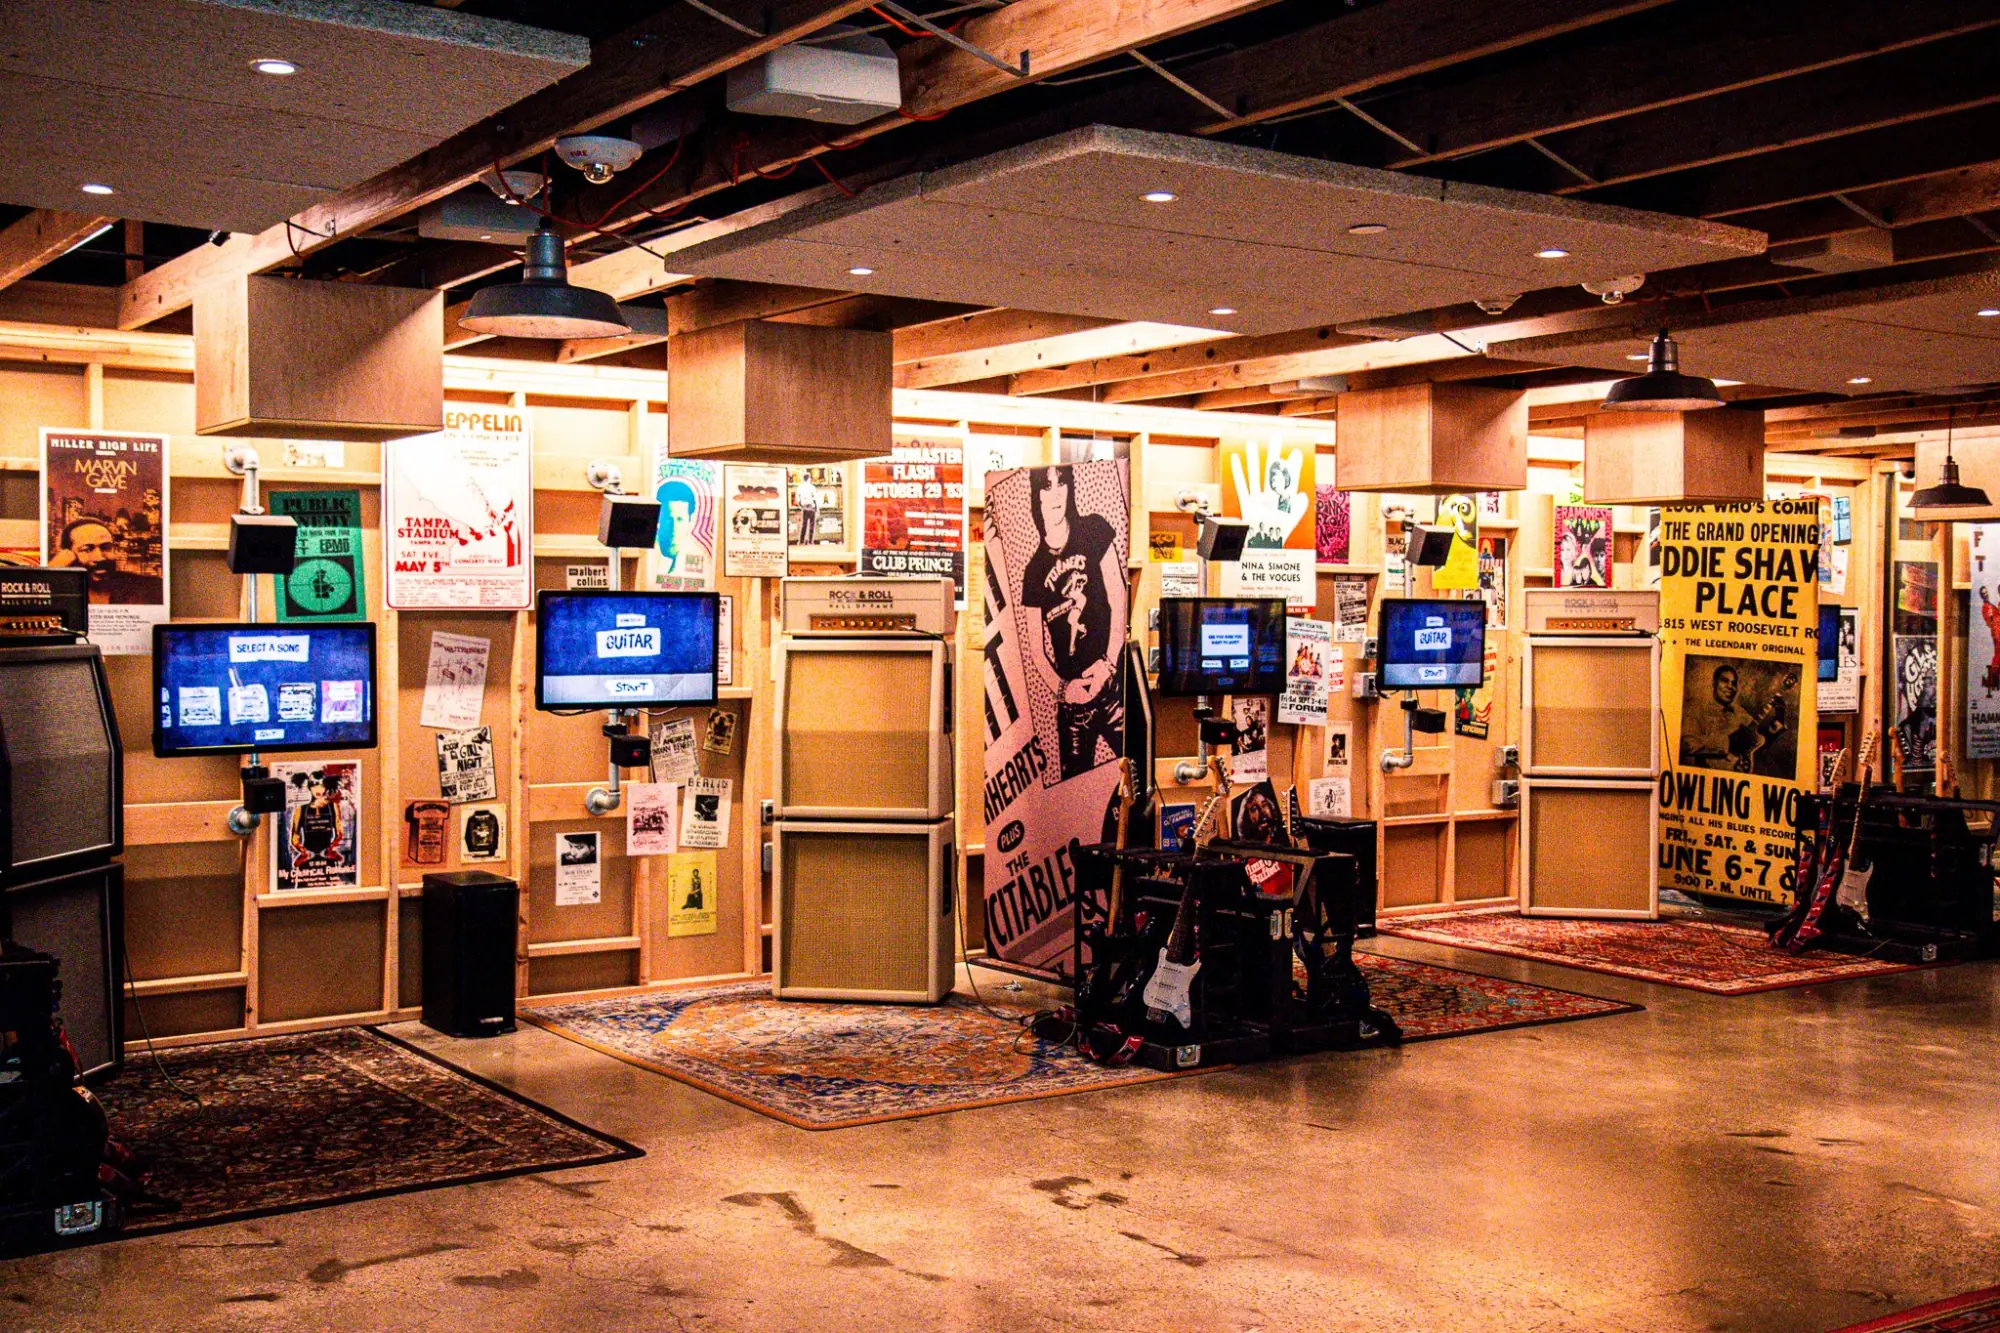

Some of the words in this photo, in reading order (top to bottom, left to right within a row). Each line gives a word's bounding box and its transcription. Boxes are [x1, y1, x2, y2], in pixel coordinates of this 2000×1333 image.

[445, 412, 522, 432] EPPELIN
[51, 438, 94, 449] MILLER
[99, 441, 128, 451] HIGH
[133, 442, 158, 452] LIFE
[865, 447, 963, 464] NDMASTER
[75, 459, 137, 475] MARVIN
[893, 464, 935, 480] FLASH
[86, 473, 128, 489] GAYE
[865, 482, 922, 498] OCTOBER
[924, 482, 942, 498] 29
[298, 515, 351, 527] NEMY
[1562, 507, 1606, 520] RAMONES
[405, 517, 451, 528] TAMPA
[398, 528, 460, 538] STADIUM
[1665, 522, 1690, 541] THE
[1697, 522, 1744, 542] GRAND
[1751, 523, 1819, 545] OPENING
[395, 561, 427, 572] MAY
[872, 556, 907, 570] CLUB
[908, 557, 952, 572] PRINCE
[1242, 562, 1264, 570] NINA
[1269, 562, 1300, 571] SIMONE
[1660, 545, 1725, 577] DDIE
[579, 567, 606, 576] albert
[1241, 573, 1247, 581] &
[1252, 573, 1266, 581] THE
[1269, 573, 1300, 582] VOGUES
[2, 583, 23, 593] ROCK
[25, 583, 31, 593] &
[32, 583, 51, 593] ROLL
[577, 578, 608, 587] collins
[829, 591, 855, 599] ROCK
[859, 591, 866, 599] &
[868, 591, 893, 599] ROLL
[1696, 581, 1799, 619] PLACE
[1659, 618, 1685, 629] 815
[1690, 619, 1723, 631] WEST
[1728, 622, 1799, 638] ROOSEVELT
[236, 644, 267, 653] SELECT
[269, 644, 275, 652] A
[277, 644, 300, 653] SONG
[1685, 638, 1701, 647] THE
[1705, 639, 1757, 651] LEGENDARY
[1762, 644, 1806, 656] ORIGINAL
[1839, 656, 1857, 668] LES
[1289, 704, 1327, 713] FORUM
[1659, 770, 1750, 819] OWLING
[1763, 784, 1804, 828] WO
[1659, 813, 1684, 824] NGING
[1689, 816, 1704, 826] ALL
[1709, 819, 1722, 828] HIS
[1727, 821, 1755, 833] BLUES
[1000, 826, 1021, 846] PLUS
[1705, 834, 1737, 850] SAT.
[1744, 840, 1756, 854] &
[1006, 851, 1030, 876] THE
[1659, 844, 1712, 876] UNE
[1725, 855, 1771, 886] 6-7
[1674, 873, 1700, 887] 9:00
[1740, 885, 1775, 902] UNTIL
